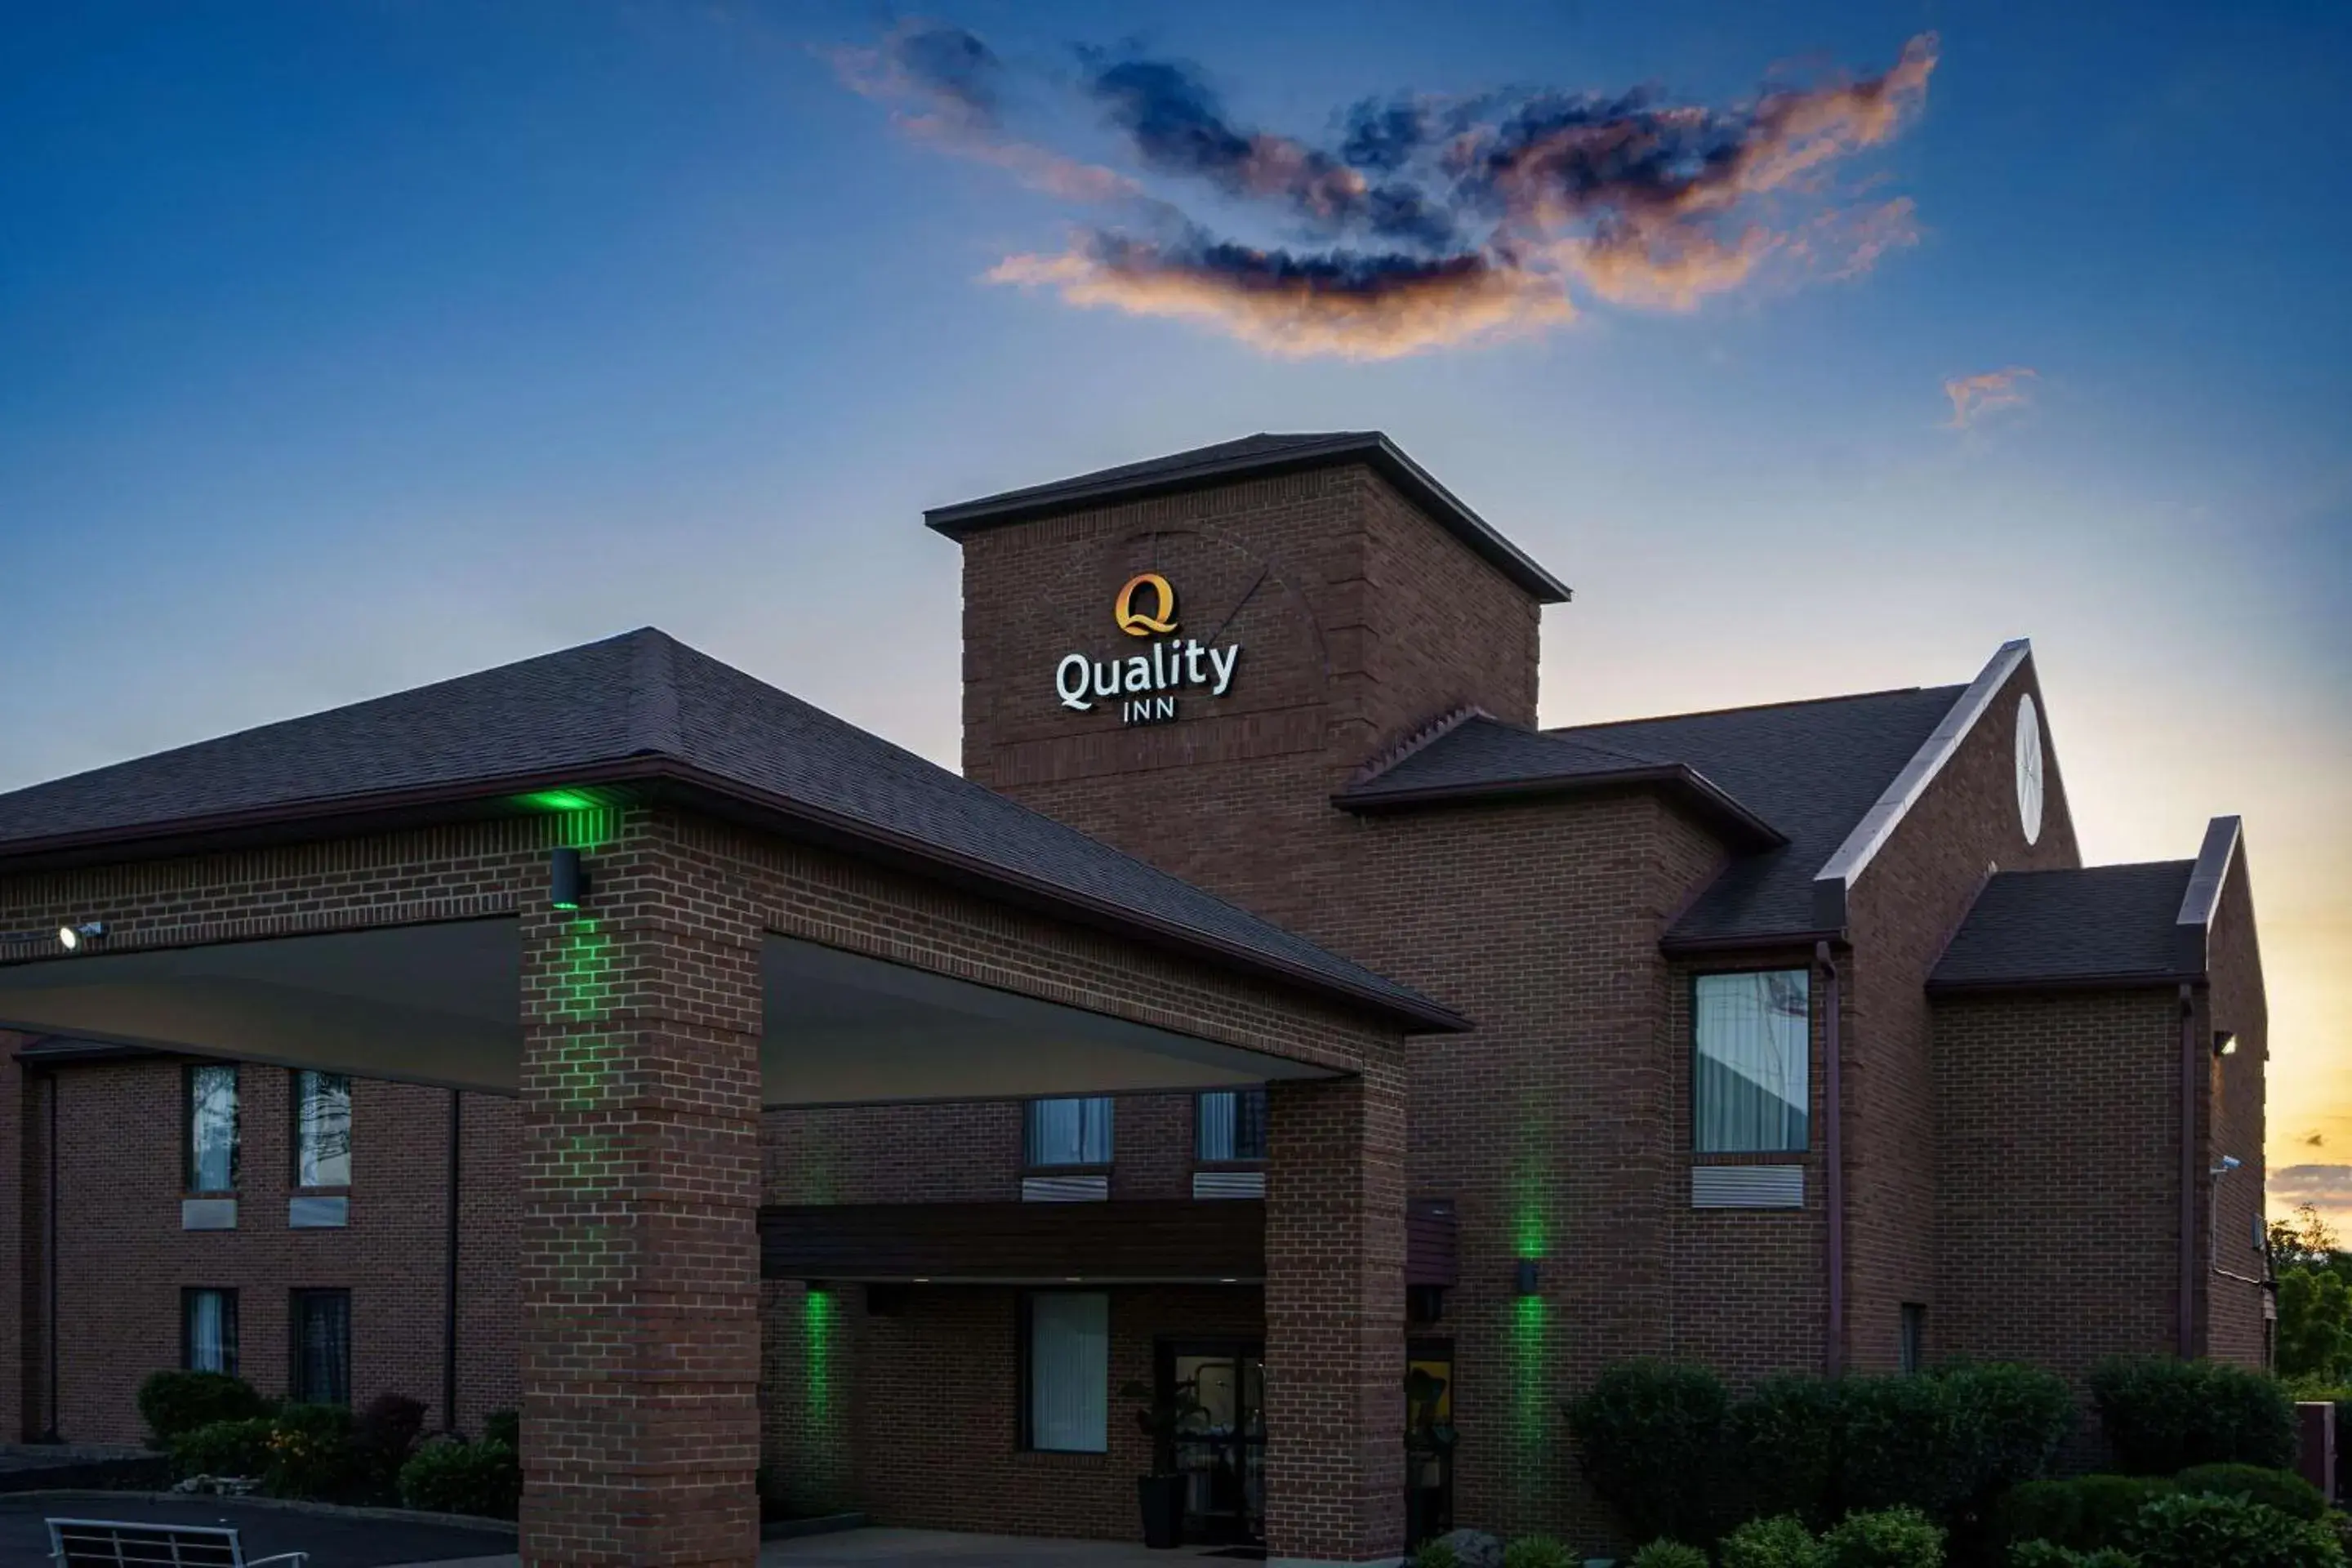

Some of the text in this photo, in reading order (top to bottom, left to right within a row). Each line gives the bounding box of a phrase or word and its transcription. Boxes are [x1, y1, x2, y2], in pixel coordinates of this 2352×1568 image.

[1115, 573, 1178, 635] Q
[1056, 639, 1239, 710] Quality
[1124, 696, 1174, 723] INN
